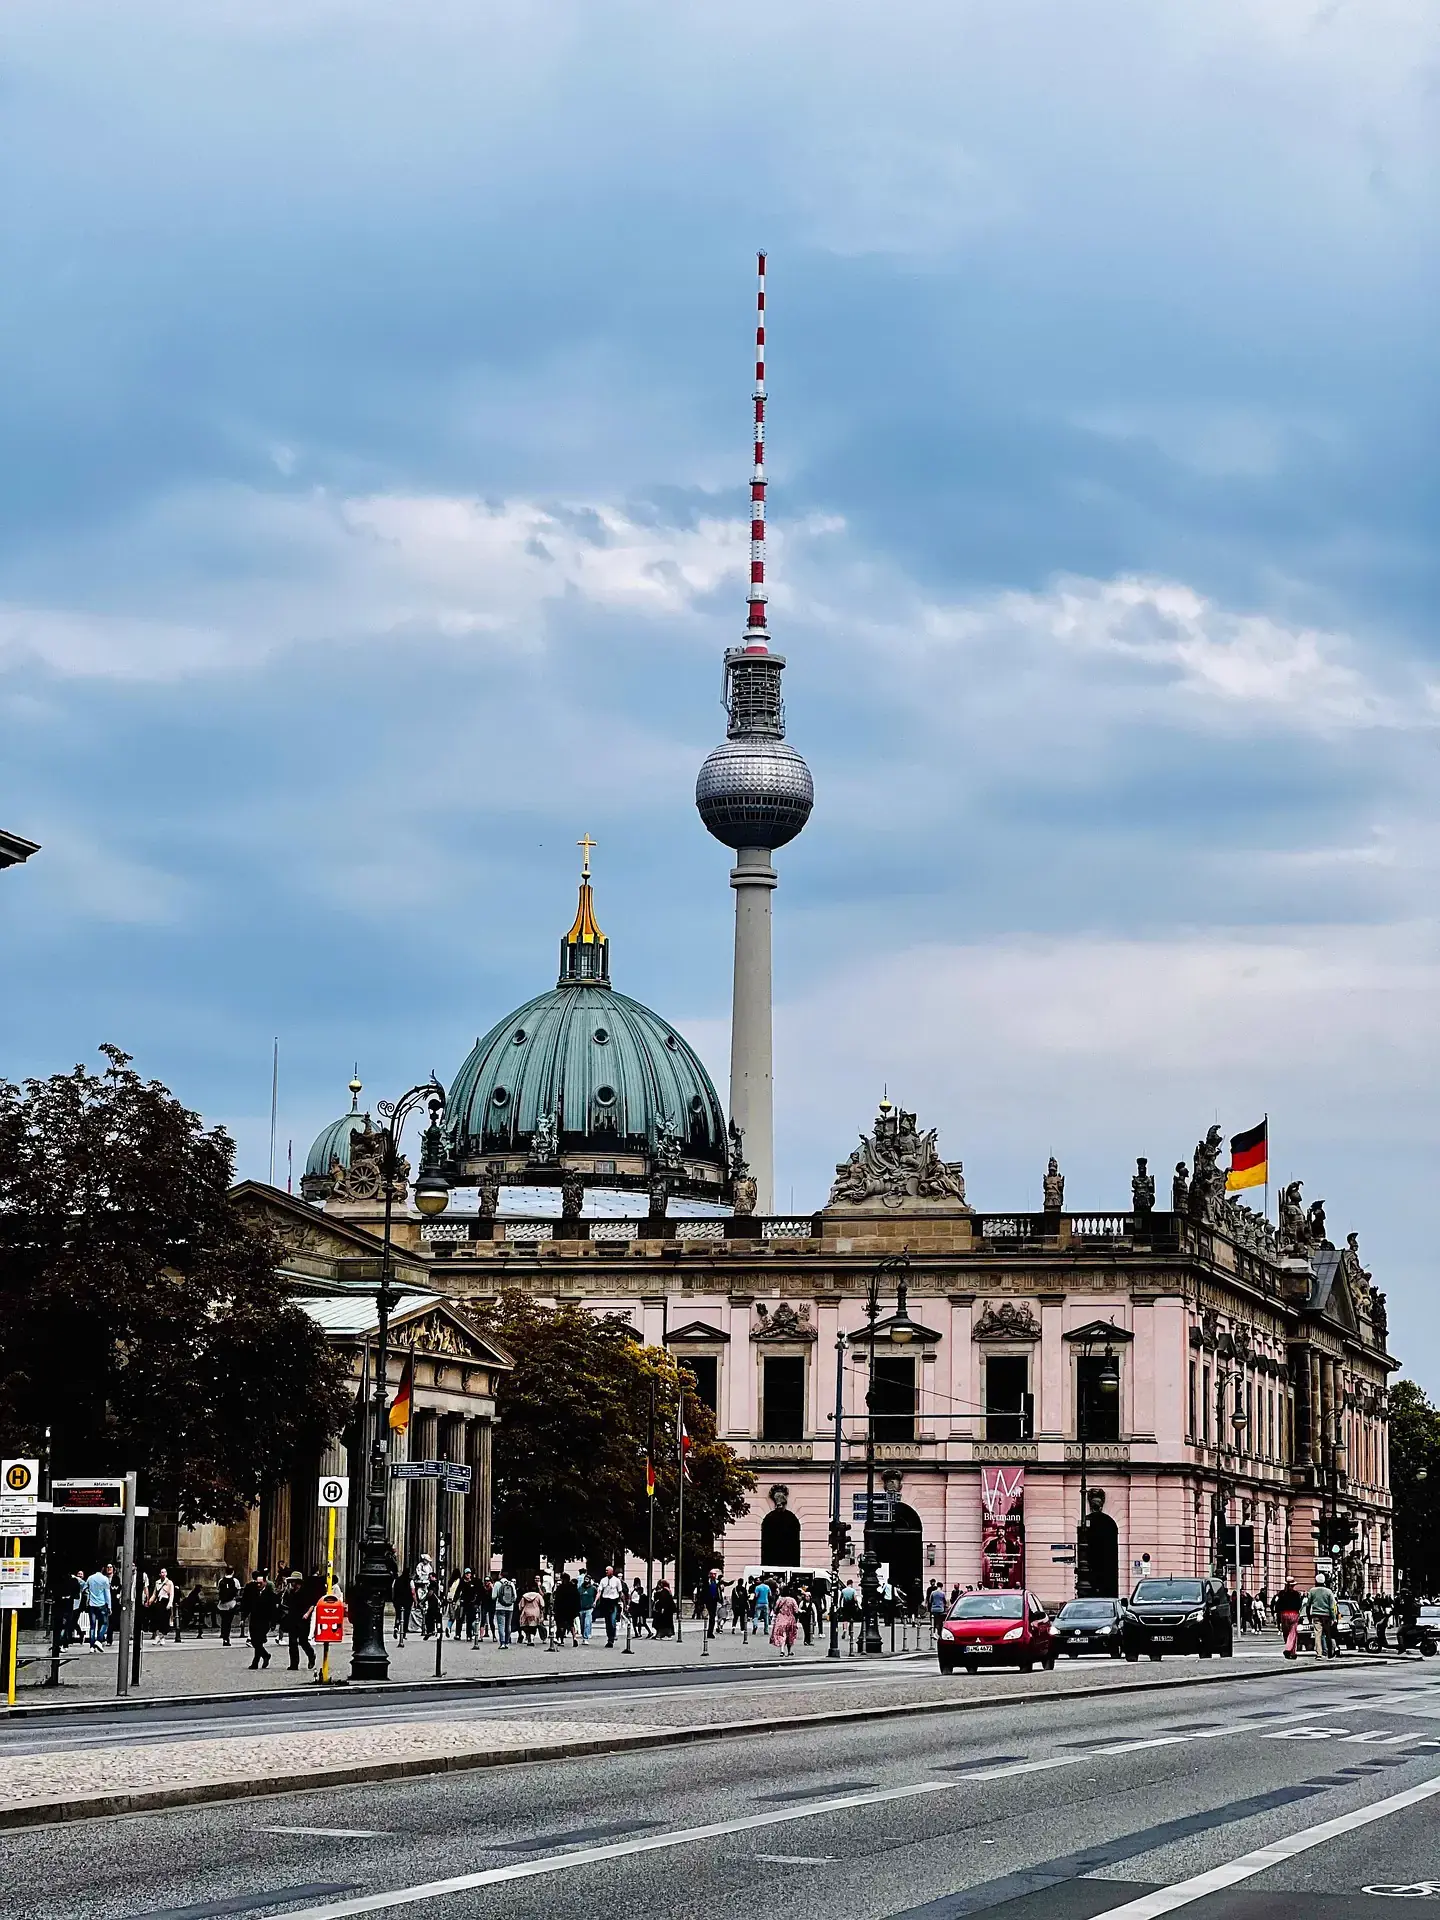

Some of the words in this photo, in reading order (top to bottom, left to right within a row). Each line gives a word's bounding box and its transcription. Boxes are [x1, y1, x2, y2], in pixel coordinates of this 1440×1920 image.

[12, 1469, 24, 1485] H
[327, 1485, 337, 1498] H
[984, 1512, 1021, 1521] Biermann
